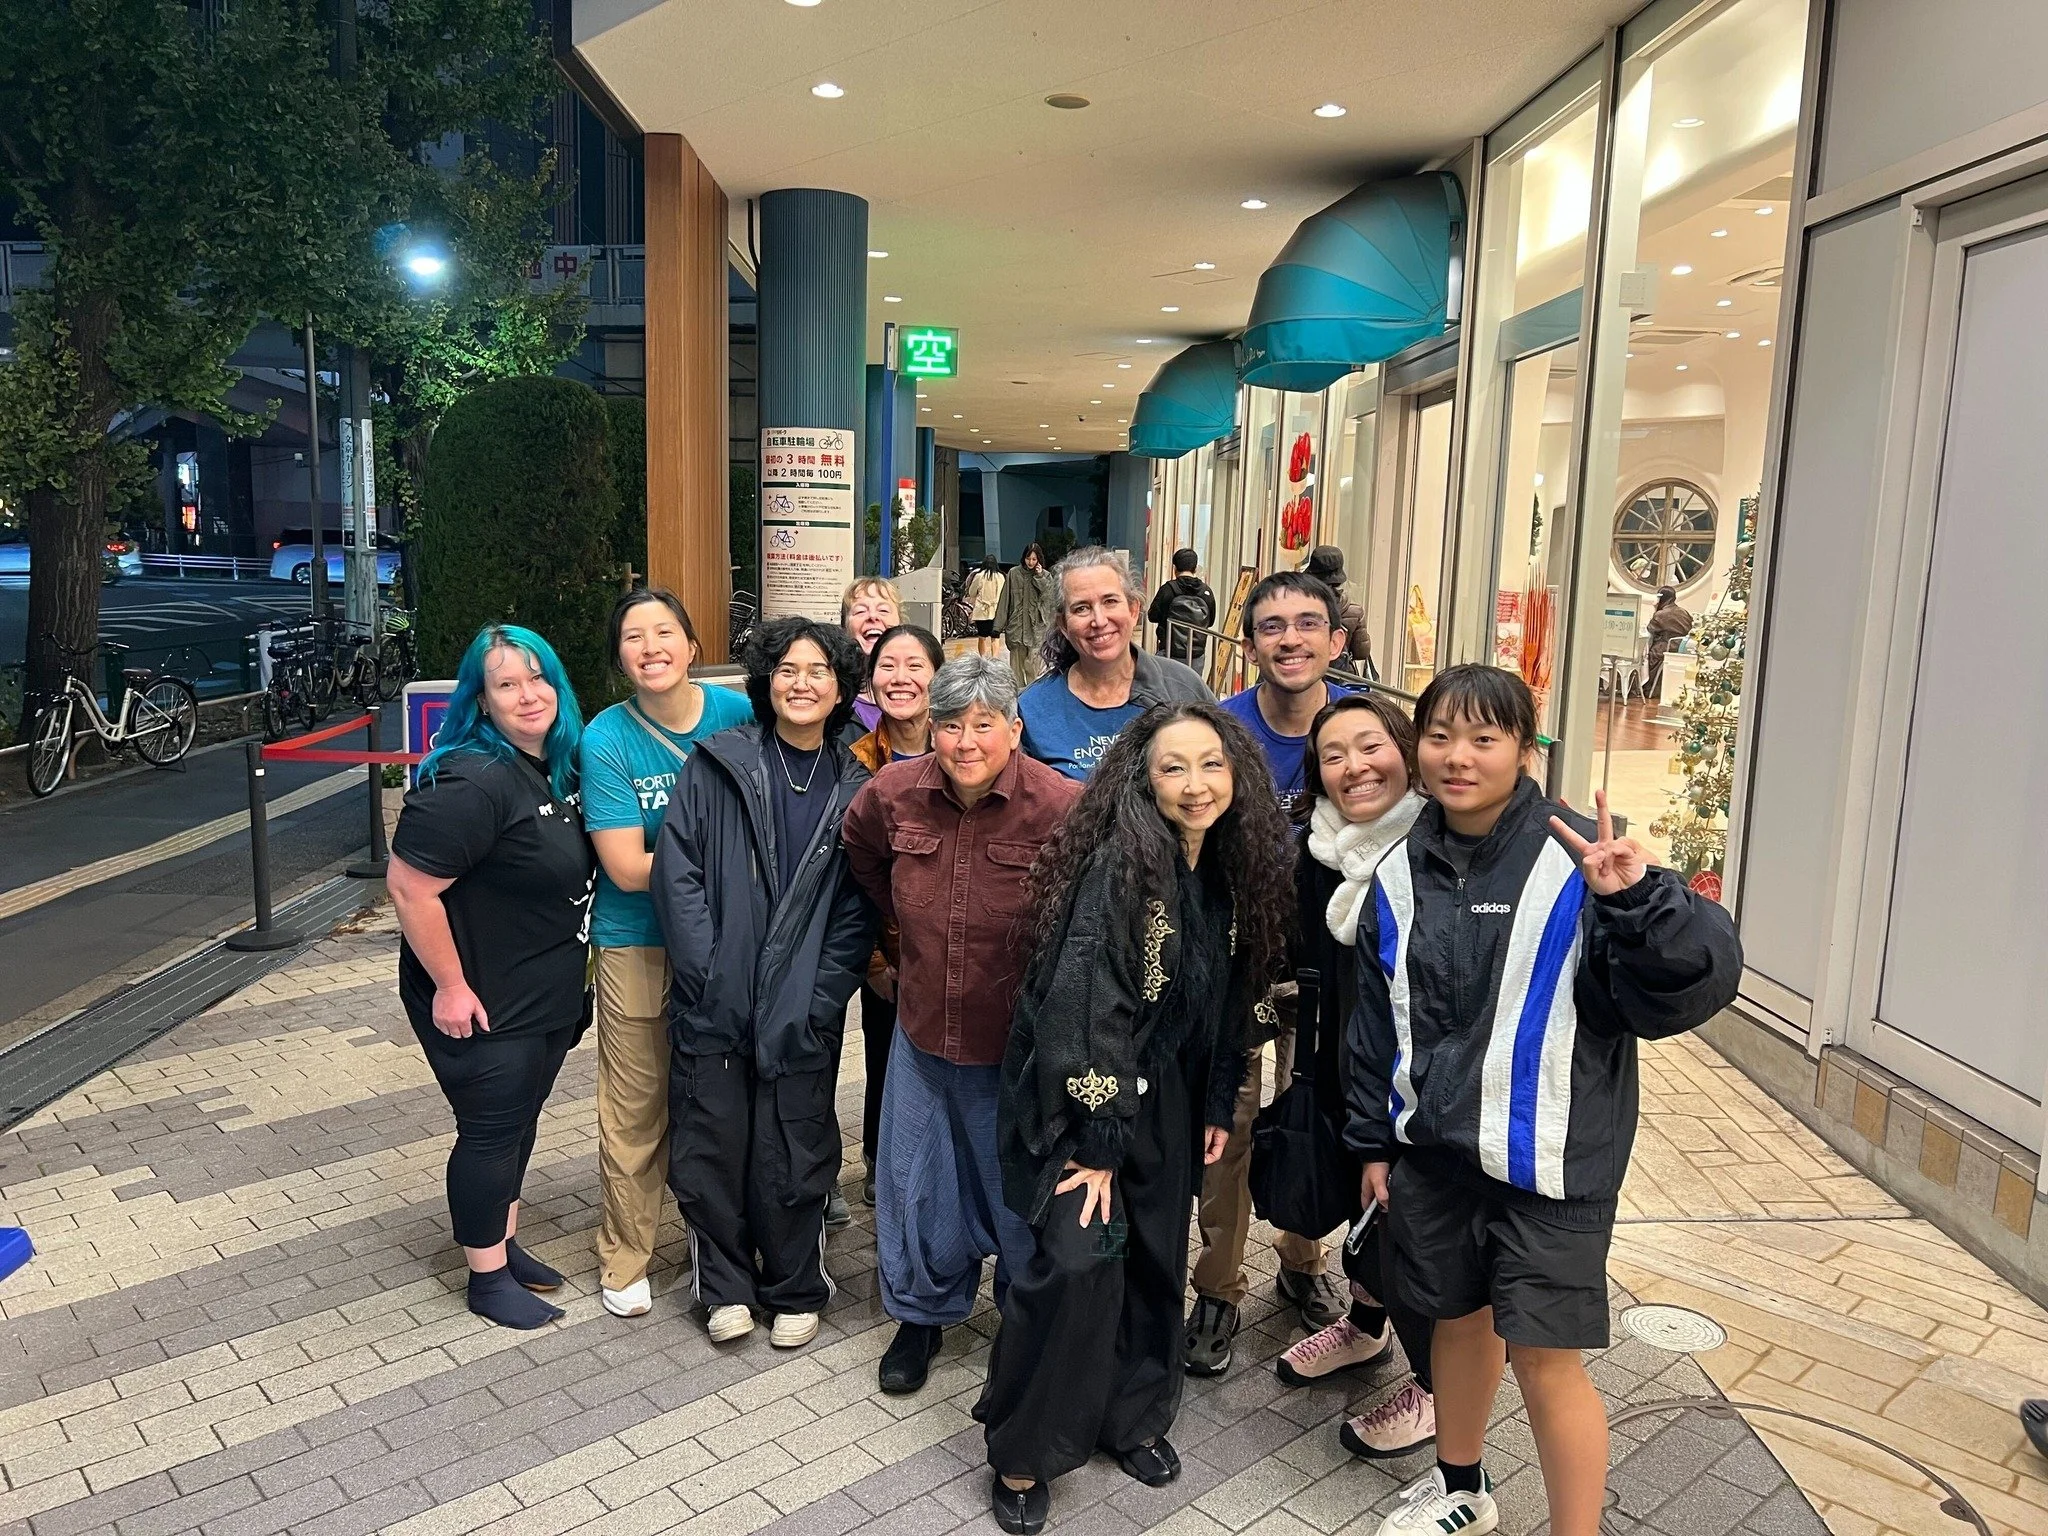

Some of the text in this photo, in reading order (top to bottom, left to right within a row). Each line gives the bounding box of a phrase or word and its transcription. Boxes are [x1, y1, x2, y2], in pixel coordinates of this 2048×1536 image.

[907, 329, 951, 374] 空
[786, 453, 794, 465] 3
[798, 455, 816, 465] 時間
[820, 453, 845, 467] 無料
[781, 468, 787, 477] 2
[790, 468, 814, 478] 時間毎
[818, 469, 842, 479] 100円
[1470, 901, 1511, 914] adidas
